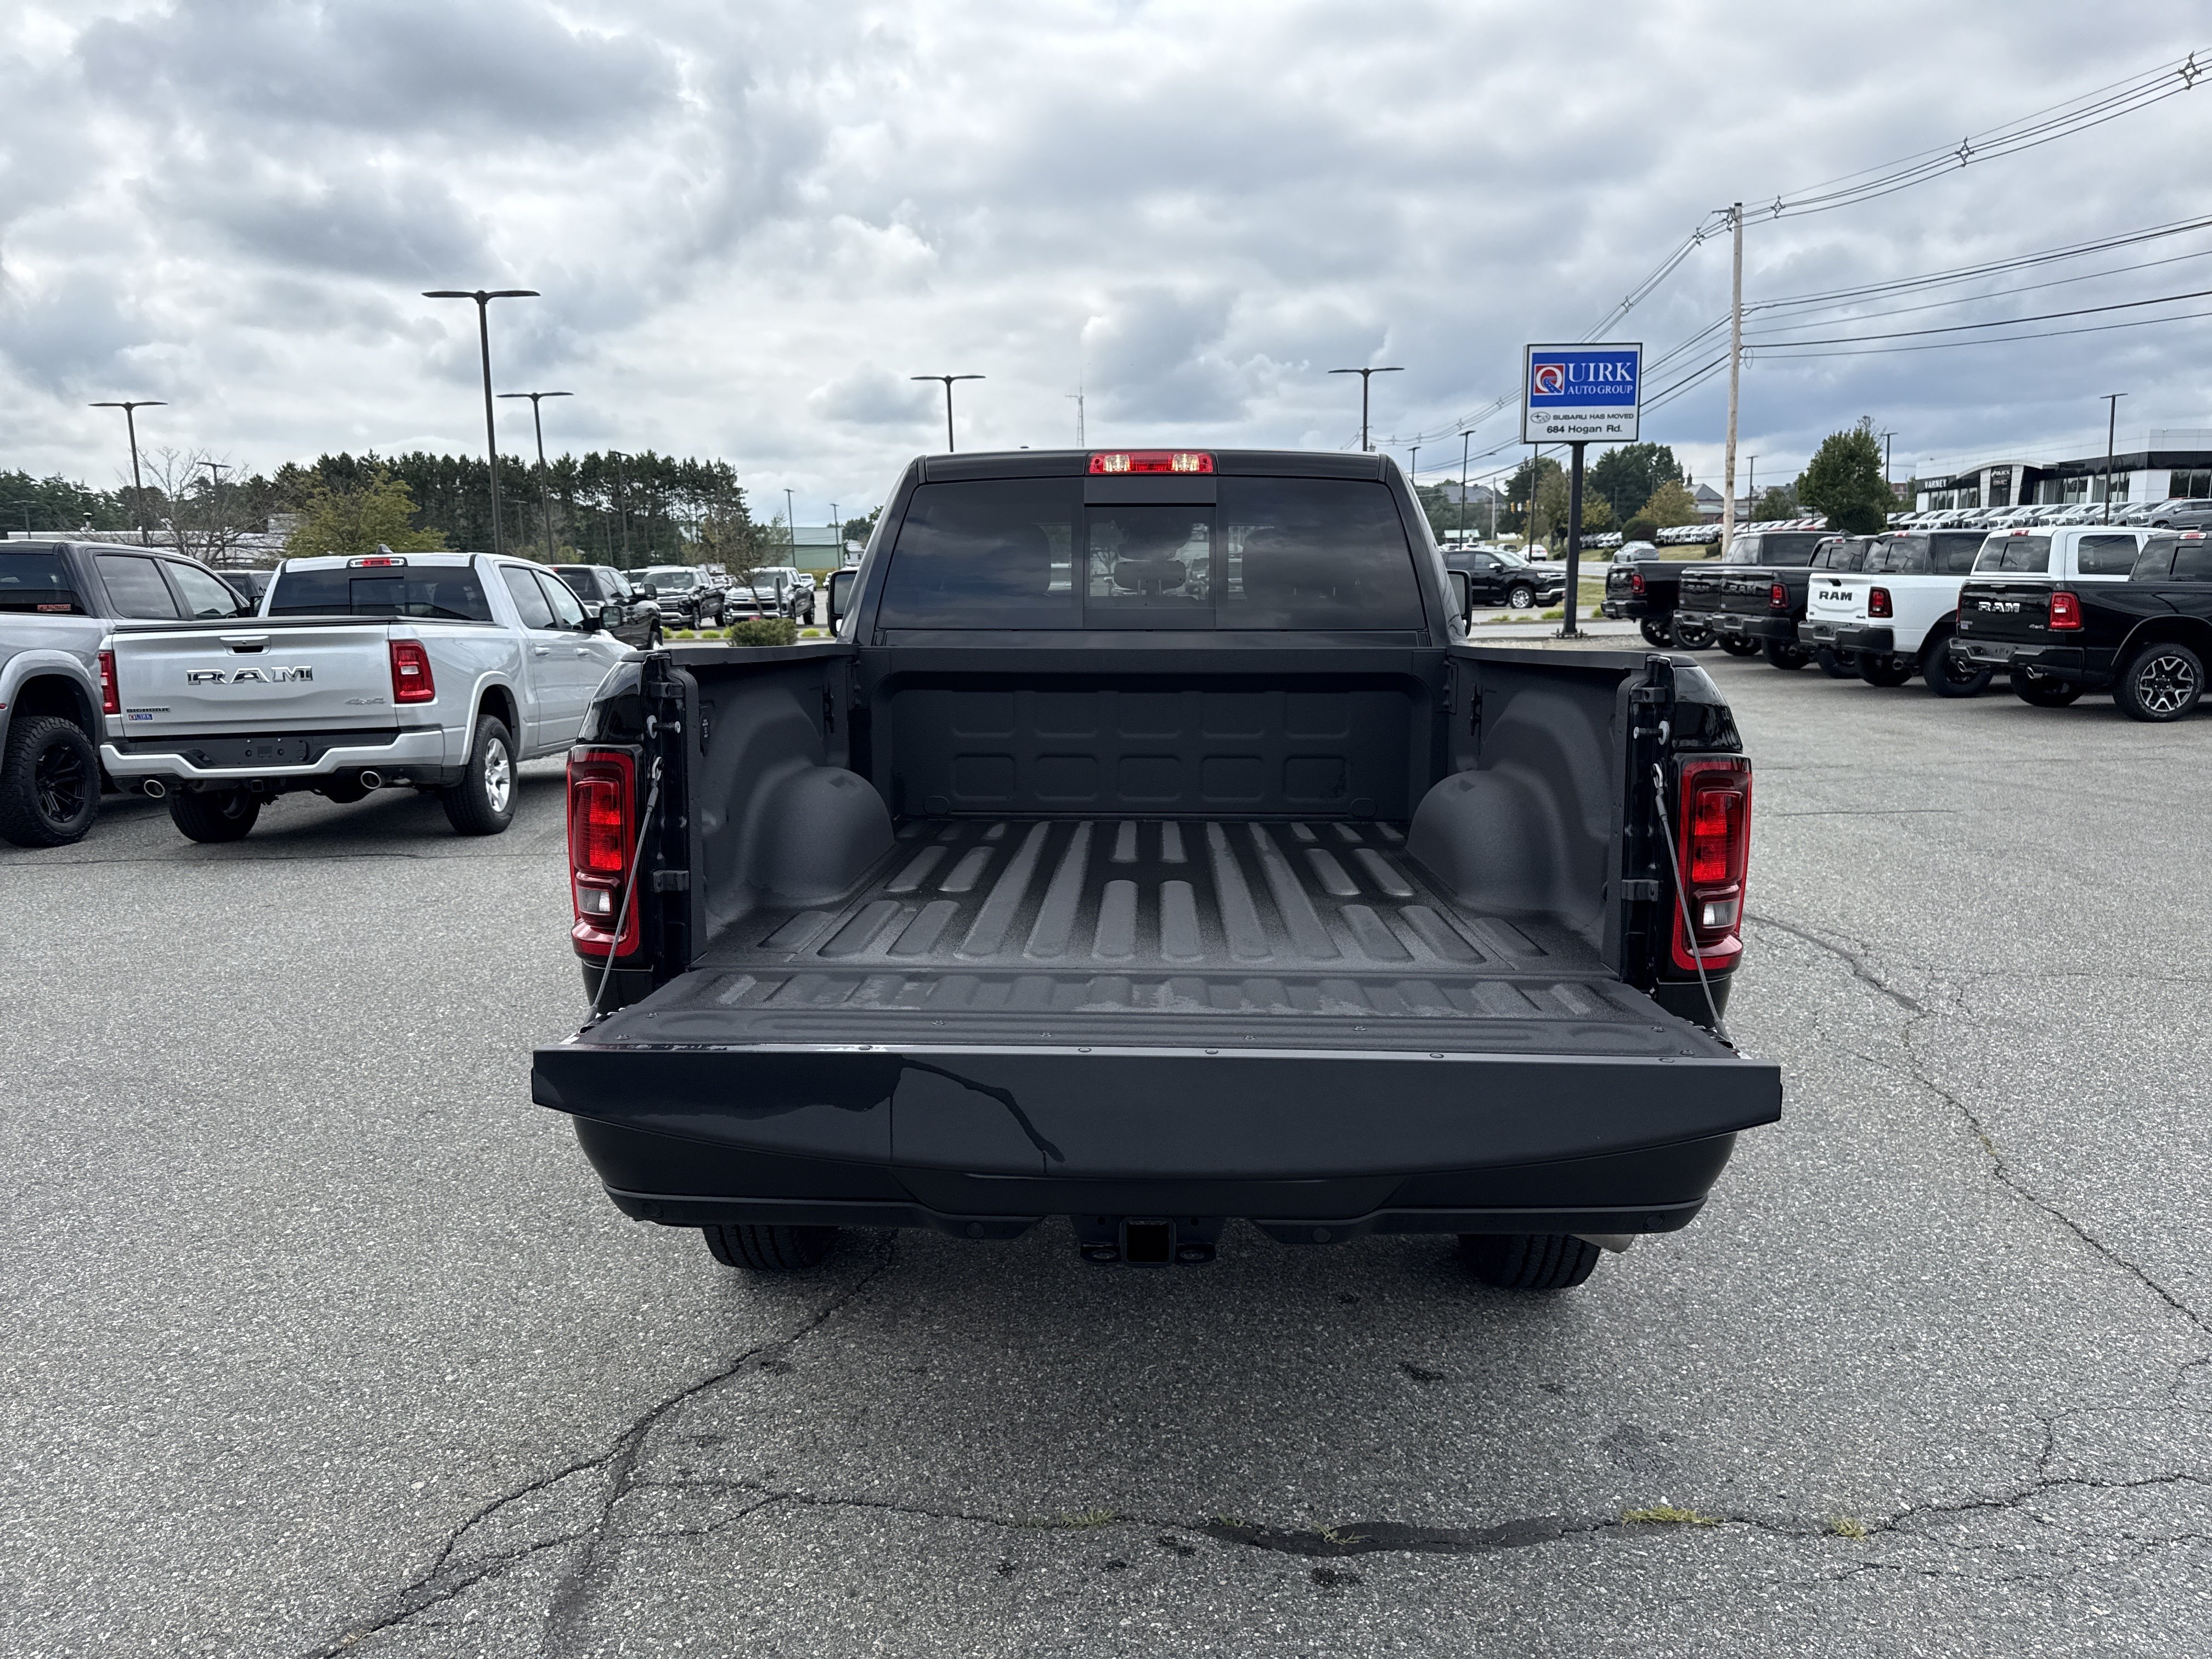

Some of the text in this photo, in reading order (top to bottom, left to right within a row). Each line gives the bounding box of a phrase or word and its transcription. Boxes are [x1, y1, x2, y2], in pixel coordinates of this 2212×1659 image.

[1536, 362, 1633, 393] QUIRK
[1567, 385, 1633, 394] AUTO GROUP
[1568, 426, 1602, 434] Hogan
[1925, 479, 1946, 489] VARNEY
[1729, 584, 1756, 594] RAM
[1819, 591, 1853, 601] RAM
[1978, 601, 2020, 613] RAM
[187, 666, 313, 685] RAM
